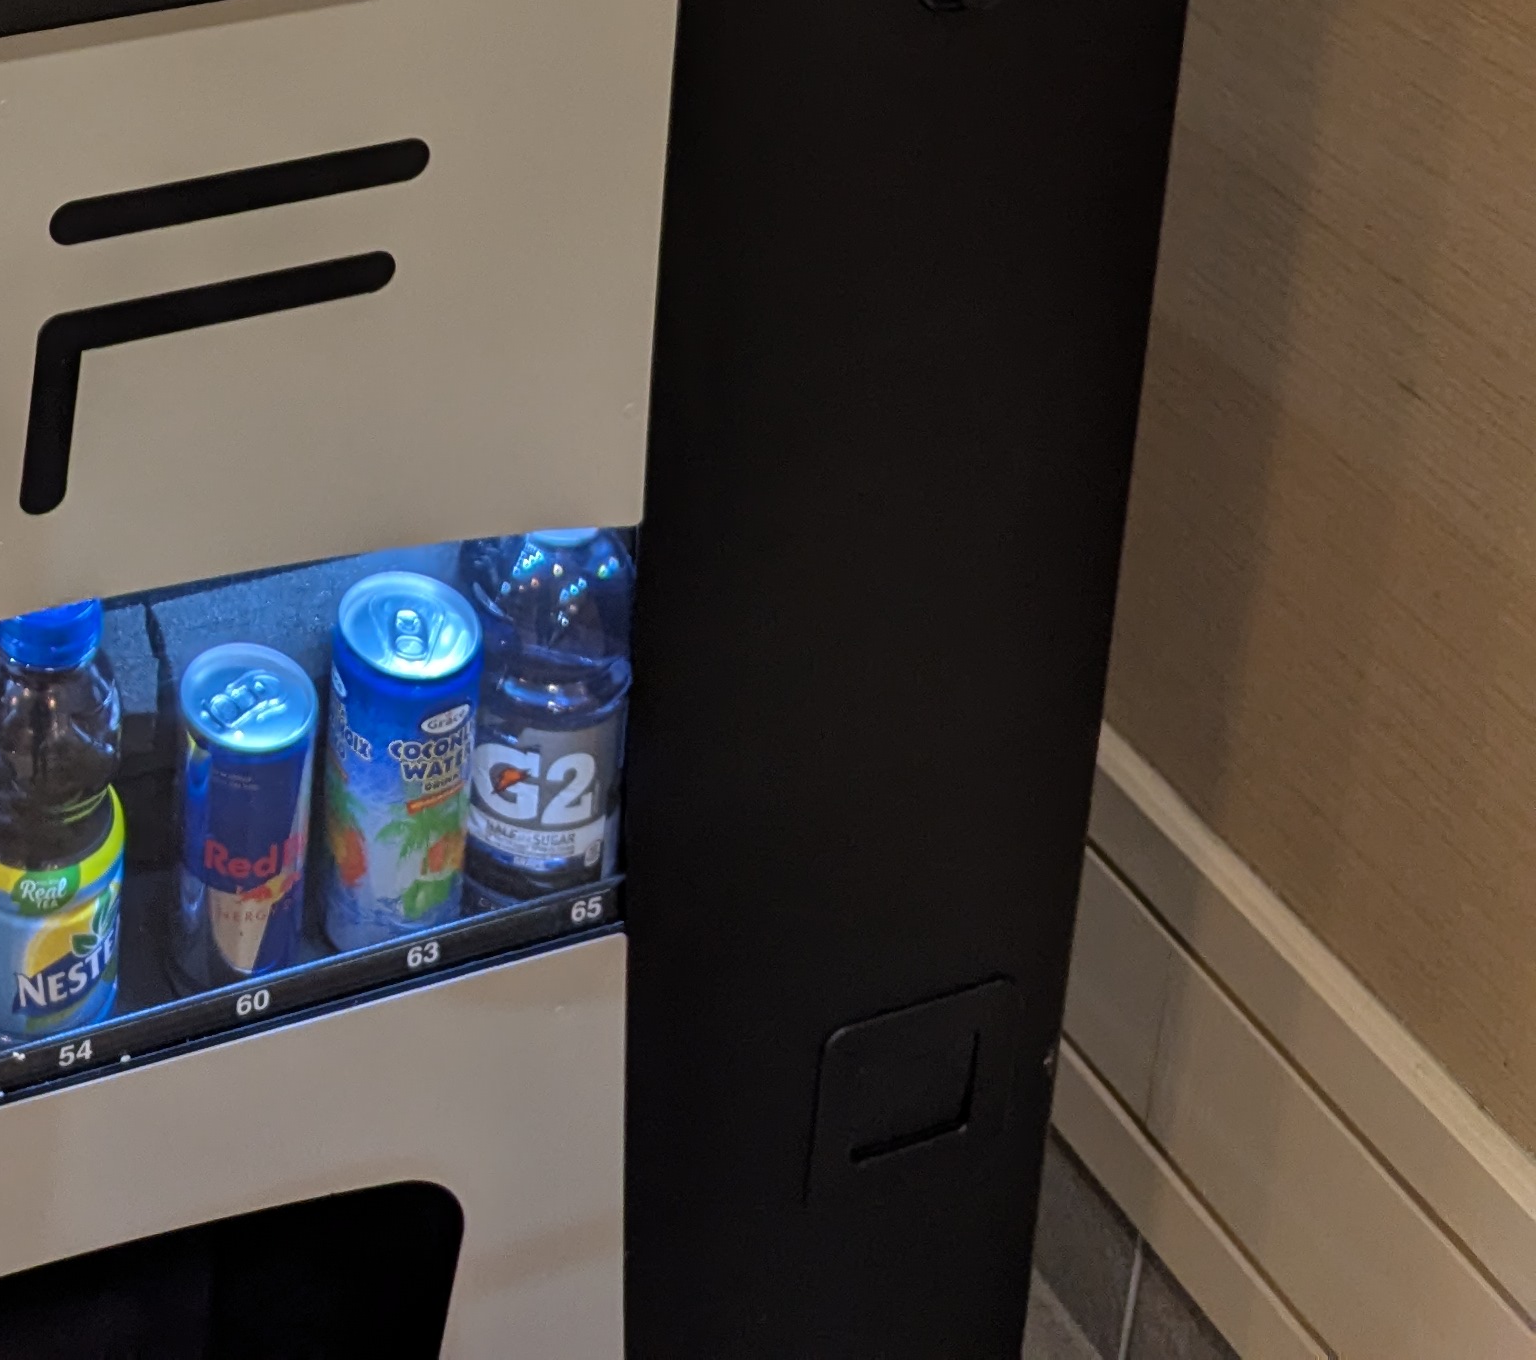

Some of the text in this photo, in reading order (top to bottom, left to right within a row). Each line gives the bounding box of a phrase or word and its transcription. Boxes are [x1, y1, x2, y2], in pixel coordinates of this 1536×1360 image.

[471, 742, 596, 825] G2
[203, 839, 278, 879] Red
[19, 877, 68, 902] Real
[35, 900, 58, 909] TEA
[571, 897, 603, 923] 65
[406, 943, 440, 968] 63
[235, 990, 270, 1016] 60
[59, 1039, 93, 1068] 54
